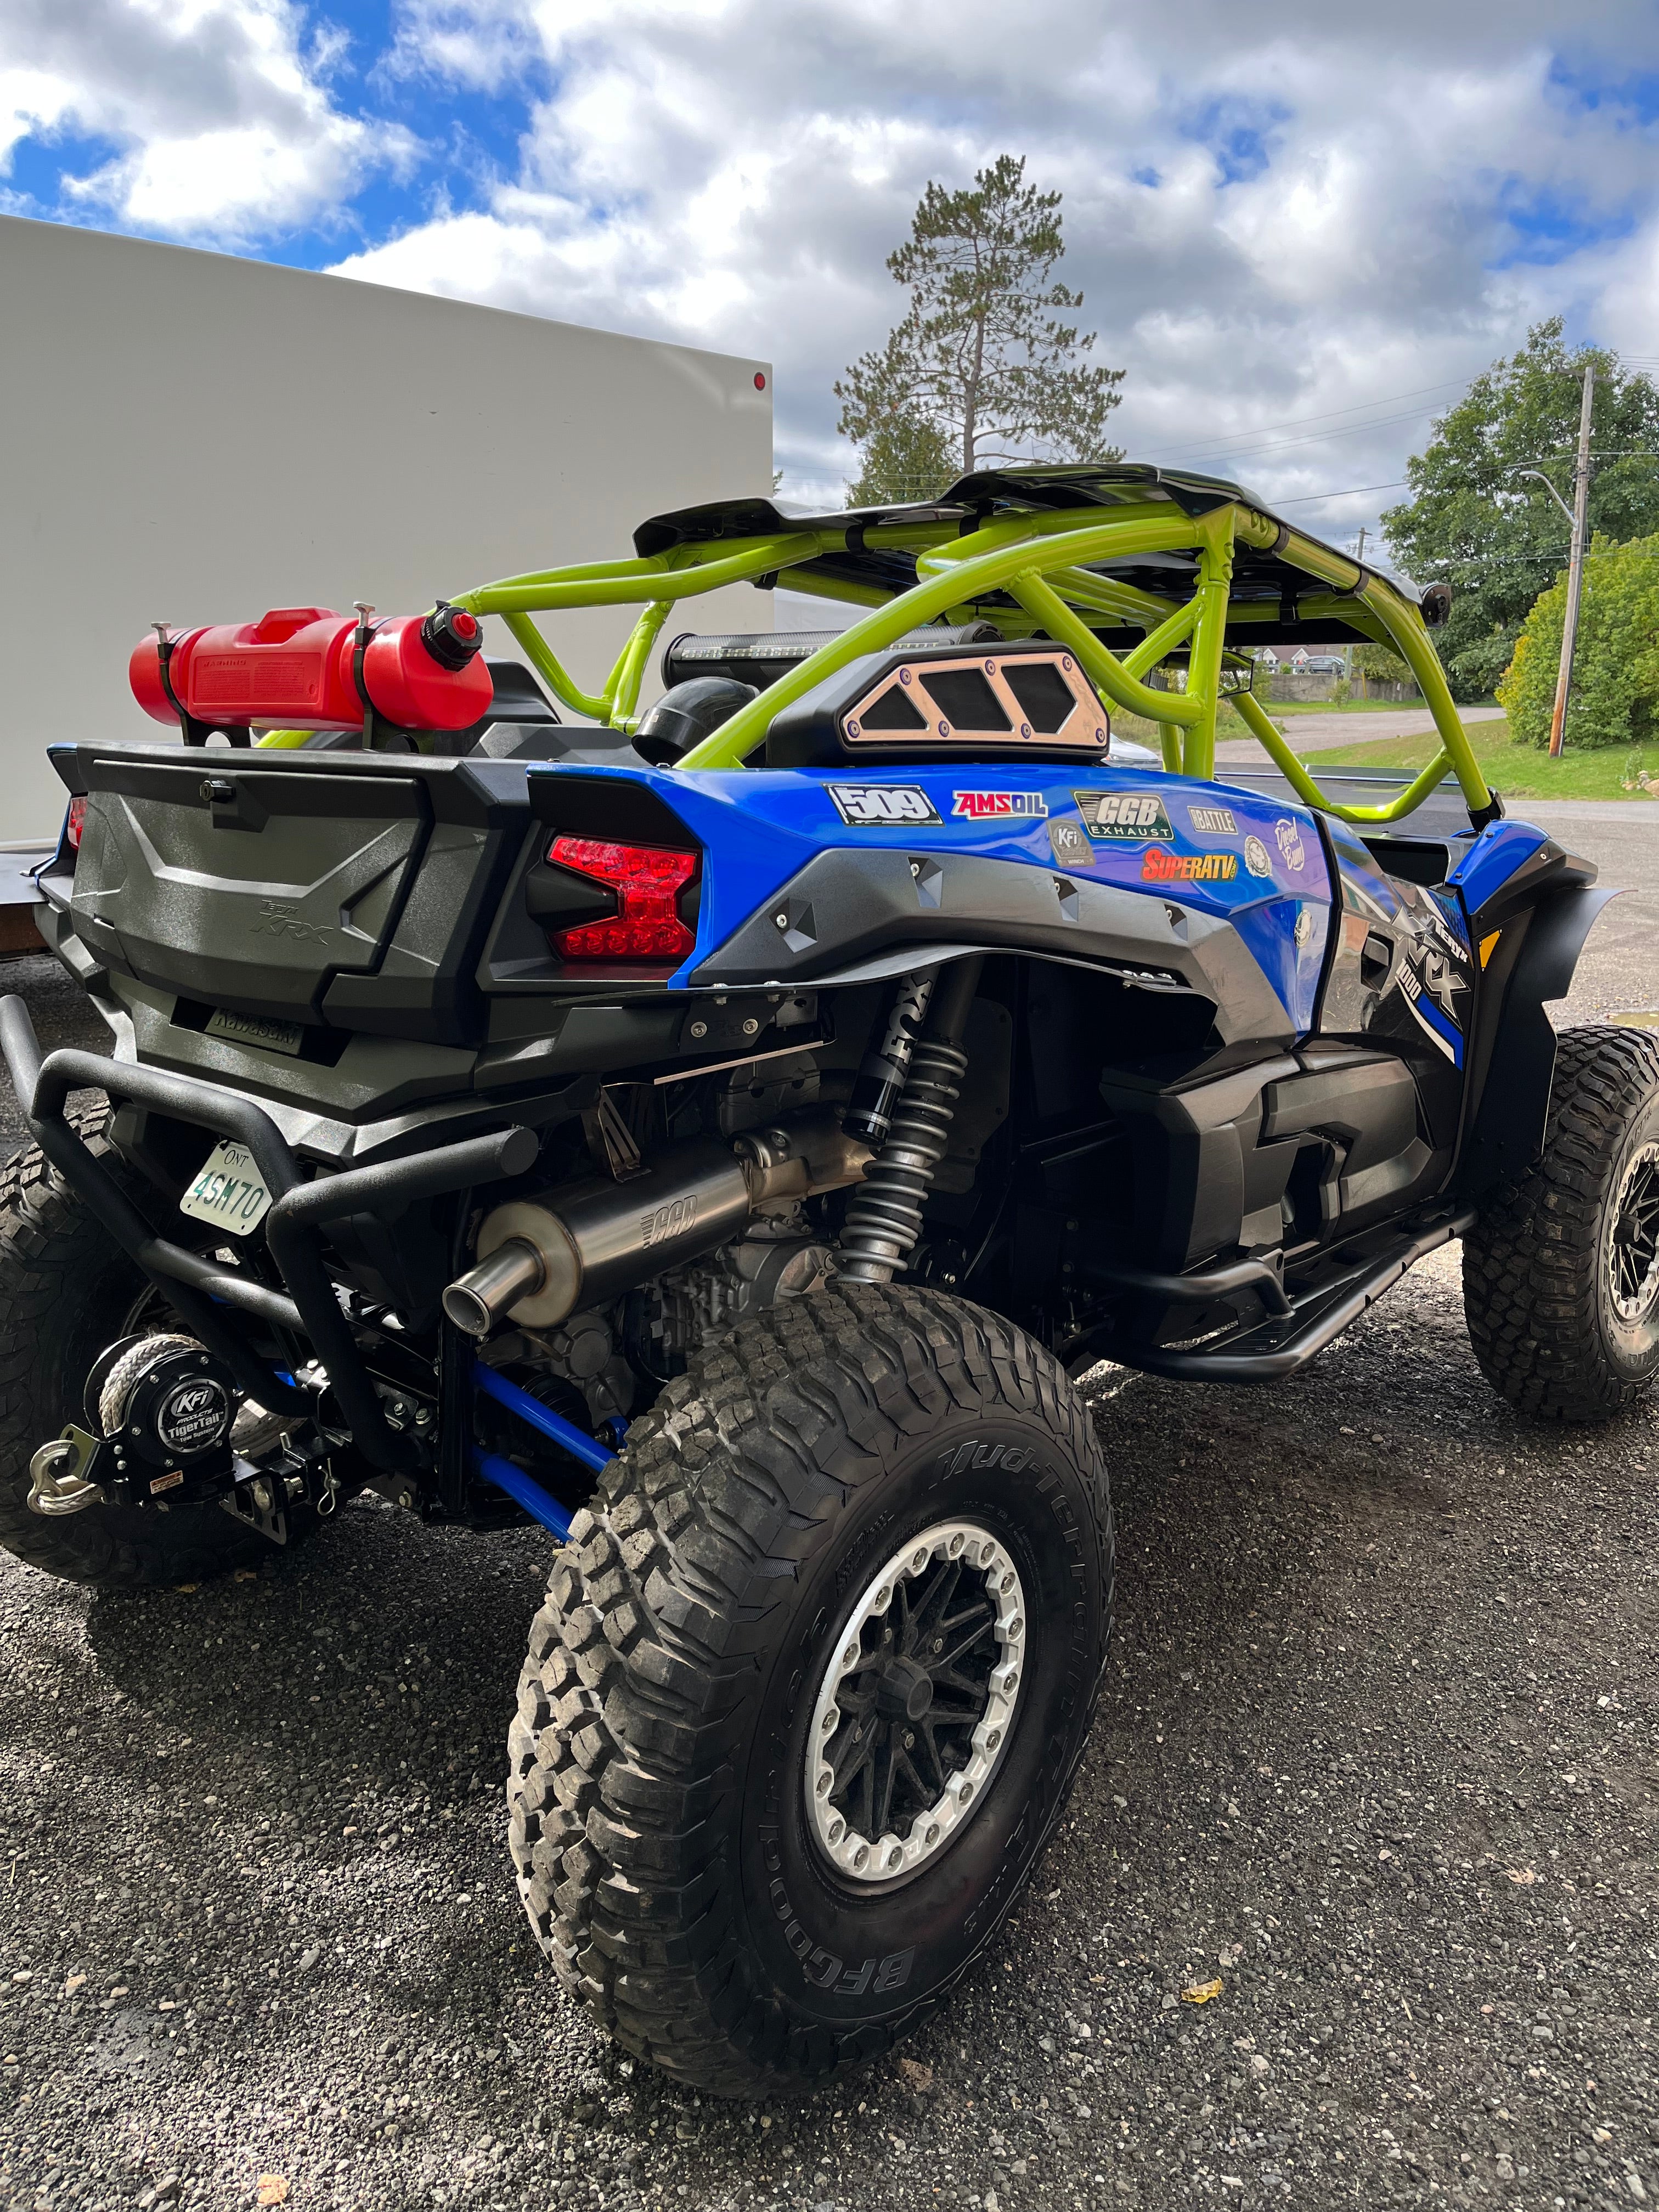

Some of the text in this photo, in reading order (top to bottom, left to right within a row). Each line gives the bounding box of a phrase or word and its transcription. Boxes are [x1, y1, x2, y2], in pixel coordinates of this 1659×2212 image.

[836, 789, 931, 819] 509
[957, 793, 1046, 817] AMSOIL
[1096, 795, 1160, 826] GGB
[1091, 825, 1170, 838] EXHAUST
[1196, 809, 1235, 832] BATTLE
[1274, 816, 1299, 851] Diesel
[248, 912, 335, 946] KRX
[1391, 905, 1468, 1019] KRX
[1395, 957, 1422, 1001] 1000
[215, 1008, 299, 1045] Kawasaki
[223, 1149, 249, 1167] ONT
[193, 1170, 264, 1219] 4SM70
[650, 1194, 698, 1246] GGB
[176, 1408, 213, 1425] PRODUCTS
[193, 1427, 215, 1438] System
[929, 1440, 1089, 1719] Mud-Terrain
